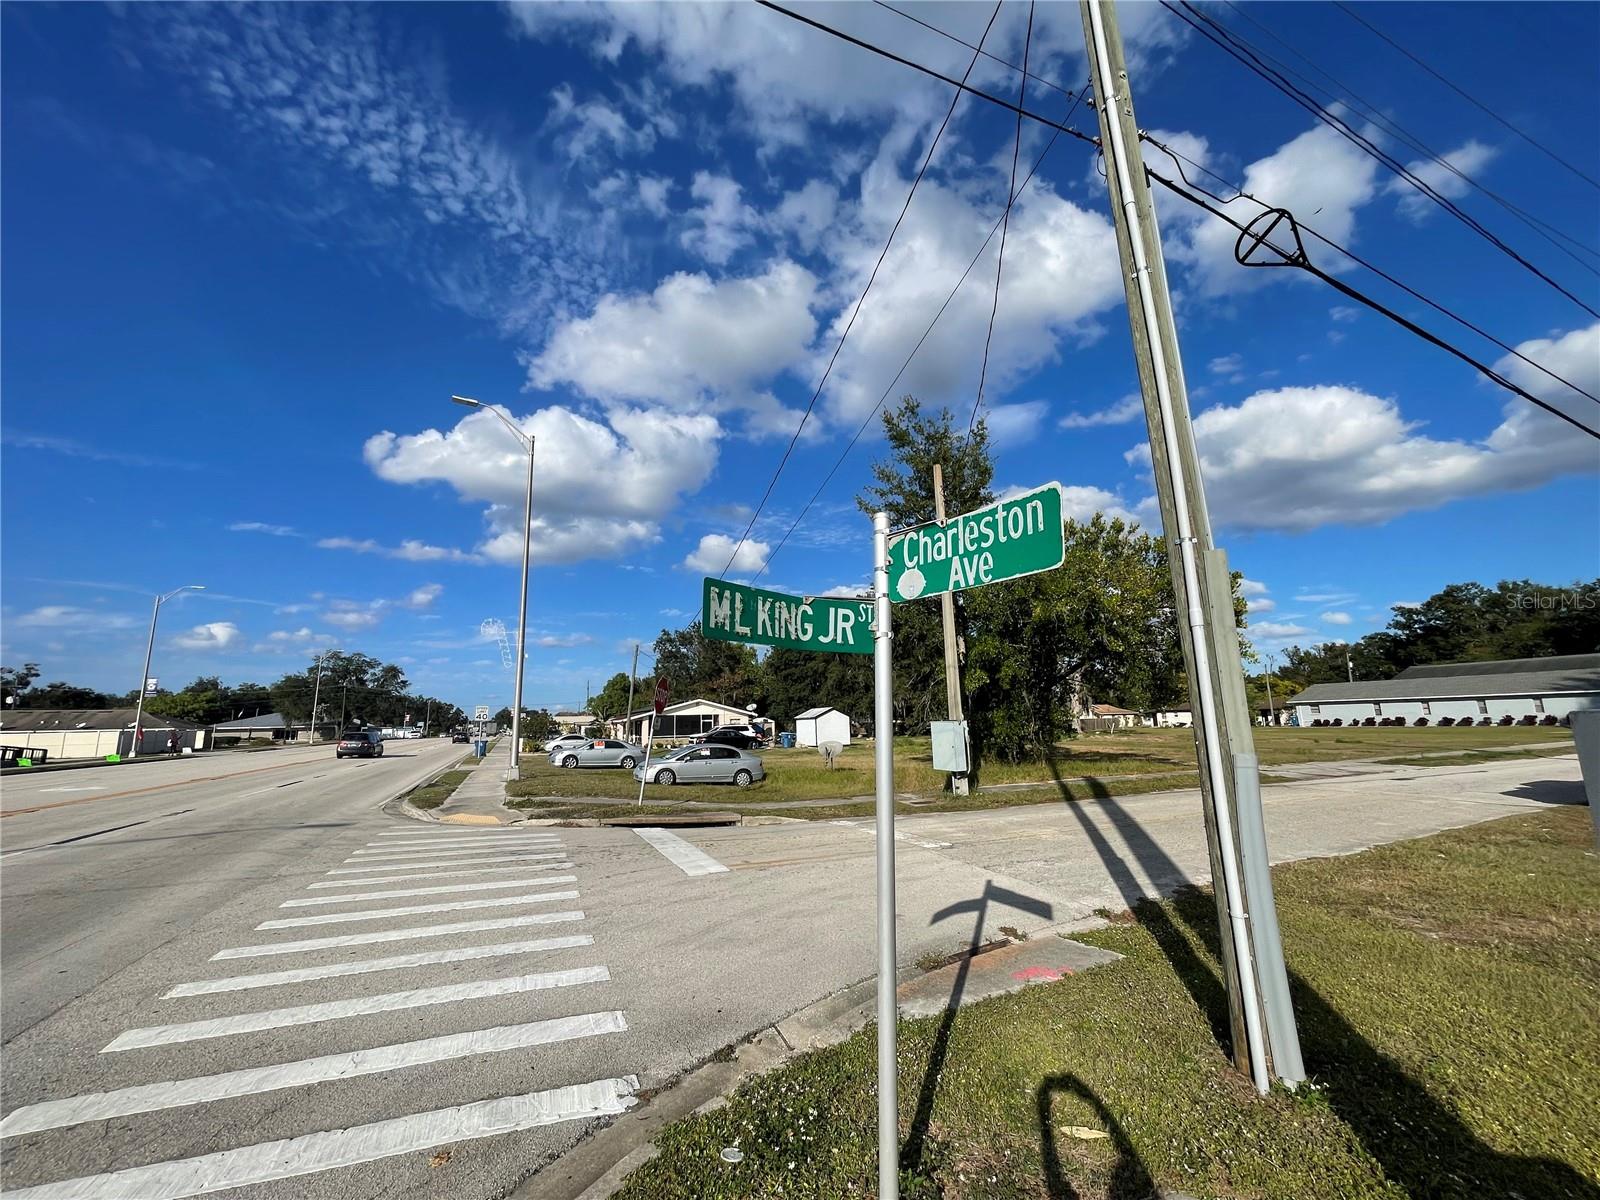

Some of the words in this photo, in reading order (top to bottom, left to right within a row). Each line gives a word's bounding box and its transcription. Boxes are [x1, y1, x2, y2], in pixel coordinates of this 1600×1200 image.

[903, 499, 1044, 568] Charleston
[948, 551, 994, 591] Ave
[757, 597, 813, 641] KING
[818, 607, 855, 644] JR
[858, 604, 874, 622] ST
